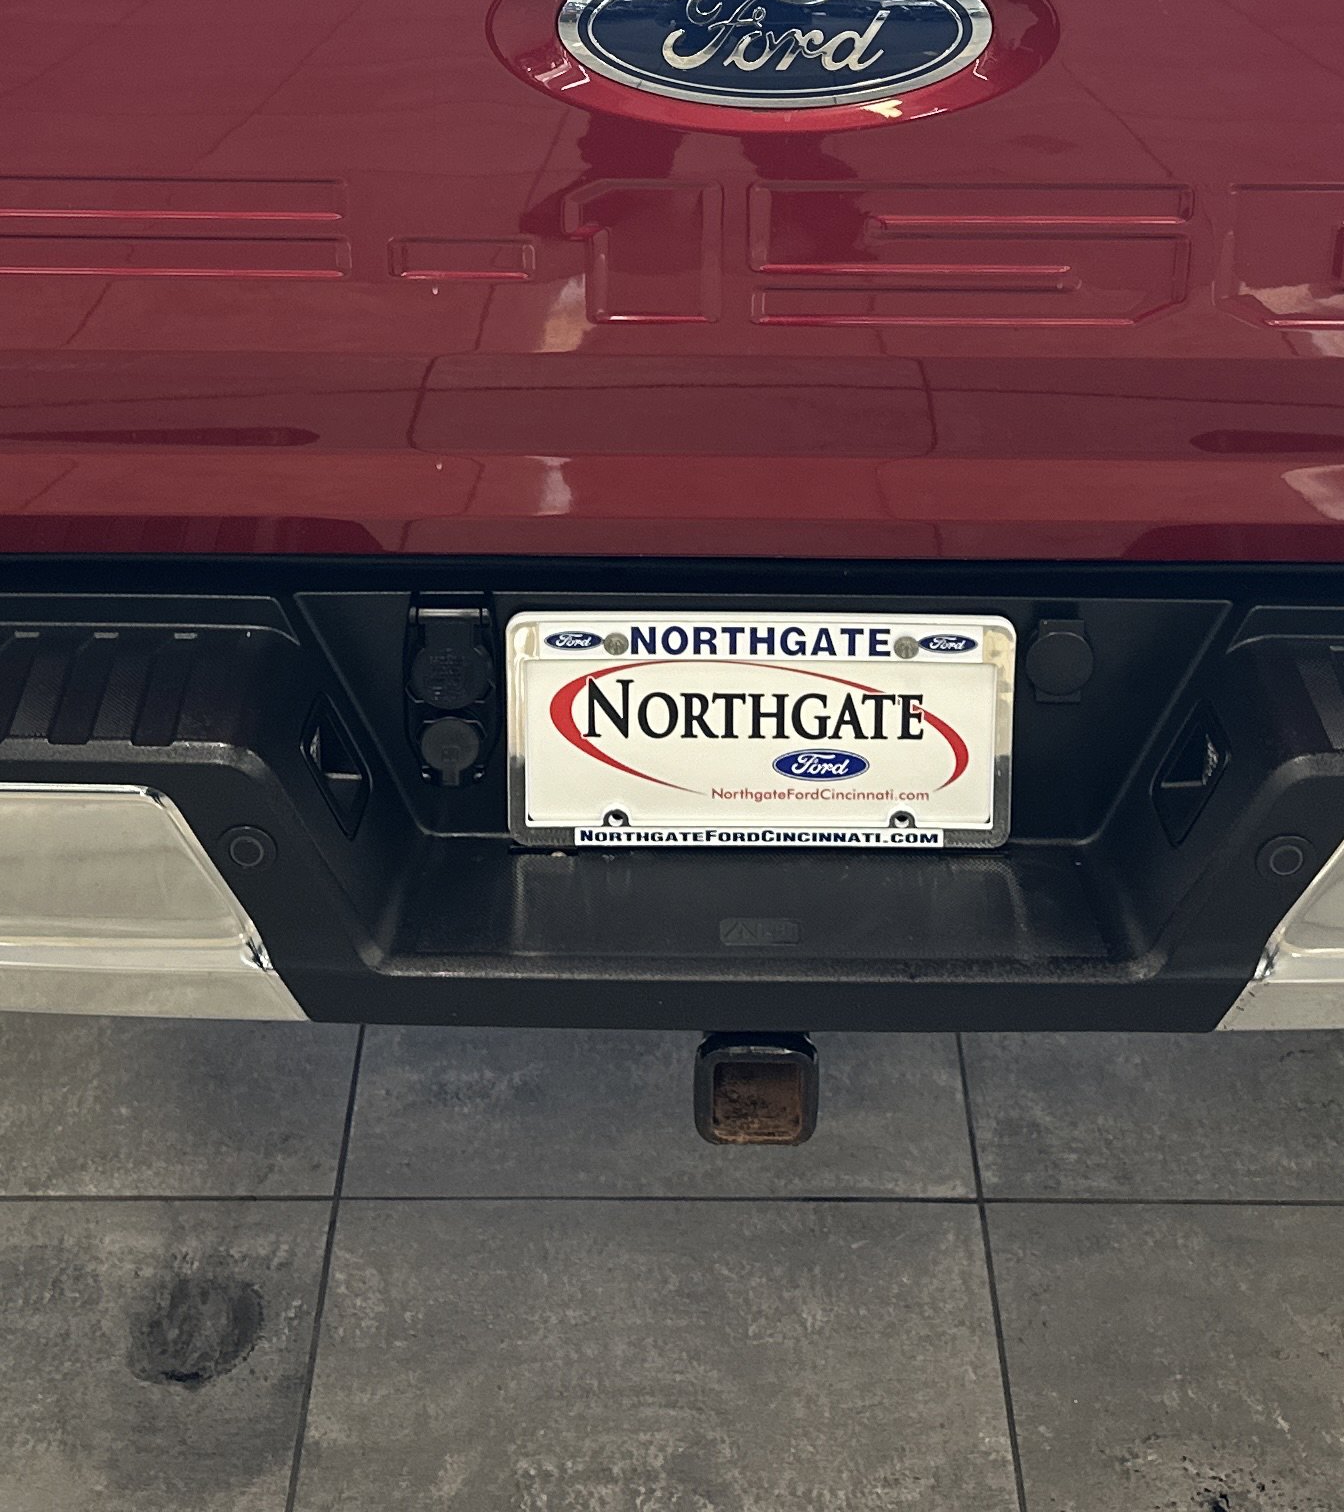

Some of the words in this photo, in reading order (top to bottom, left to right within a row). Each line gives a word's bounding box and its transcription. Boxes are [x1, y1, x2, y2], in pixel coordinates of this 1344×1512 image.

[555, 633, 593, 648] Ford
[630, 625, 891, 657] NORTHGATE
[929, 636, 965, 650] Ford
[582, 677, 924, 740] NORTHGATE
[790, 752, 851, 777] Ford
[711, 788, 930, 802] NorthgateFordCincinnati.com
